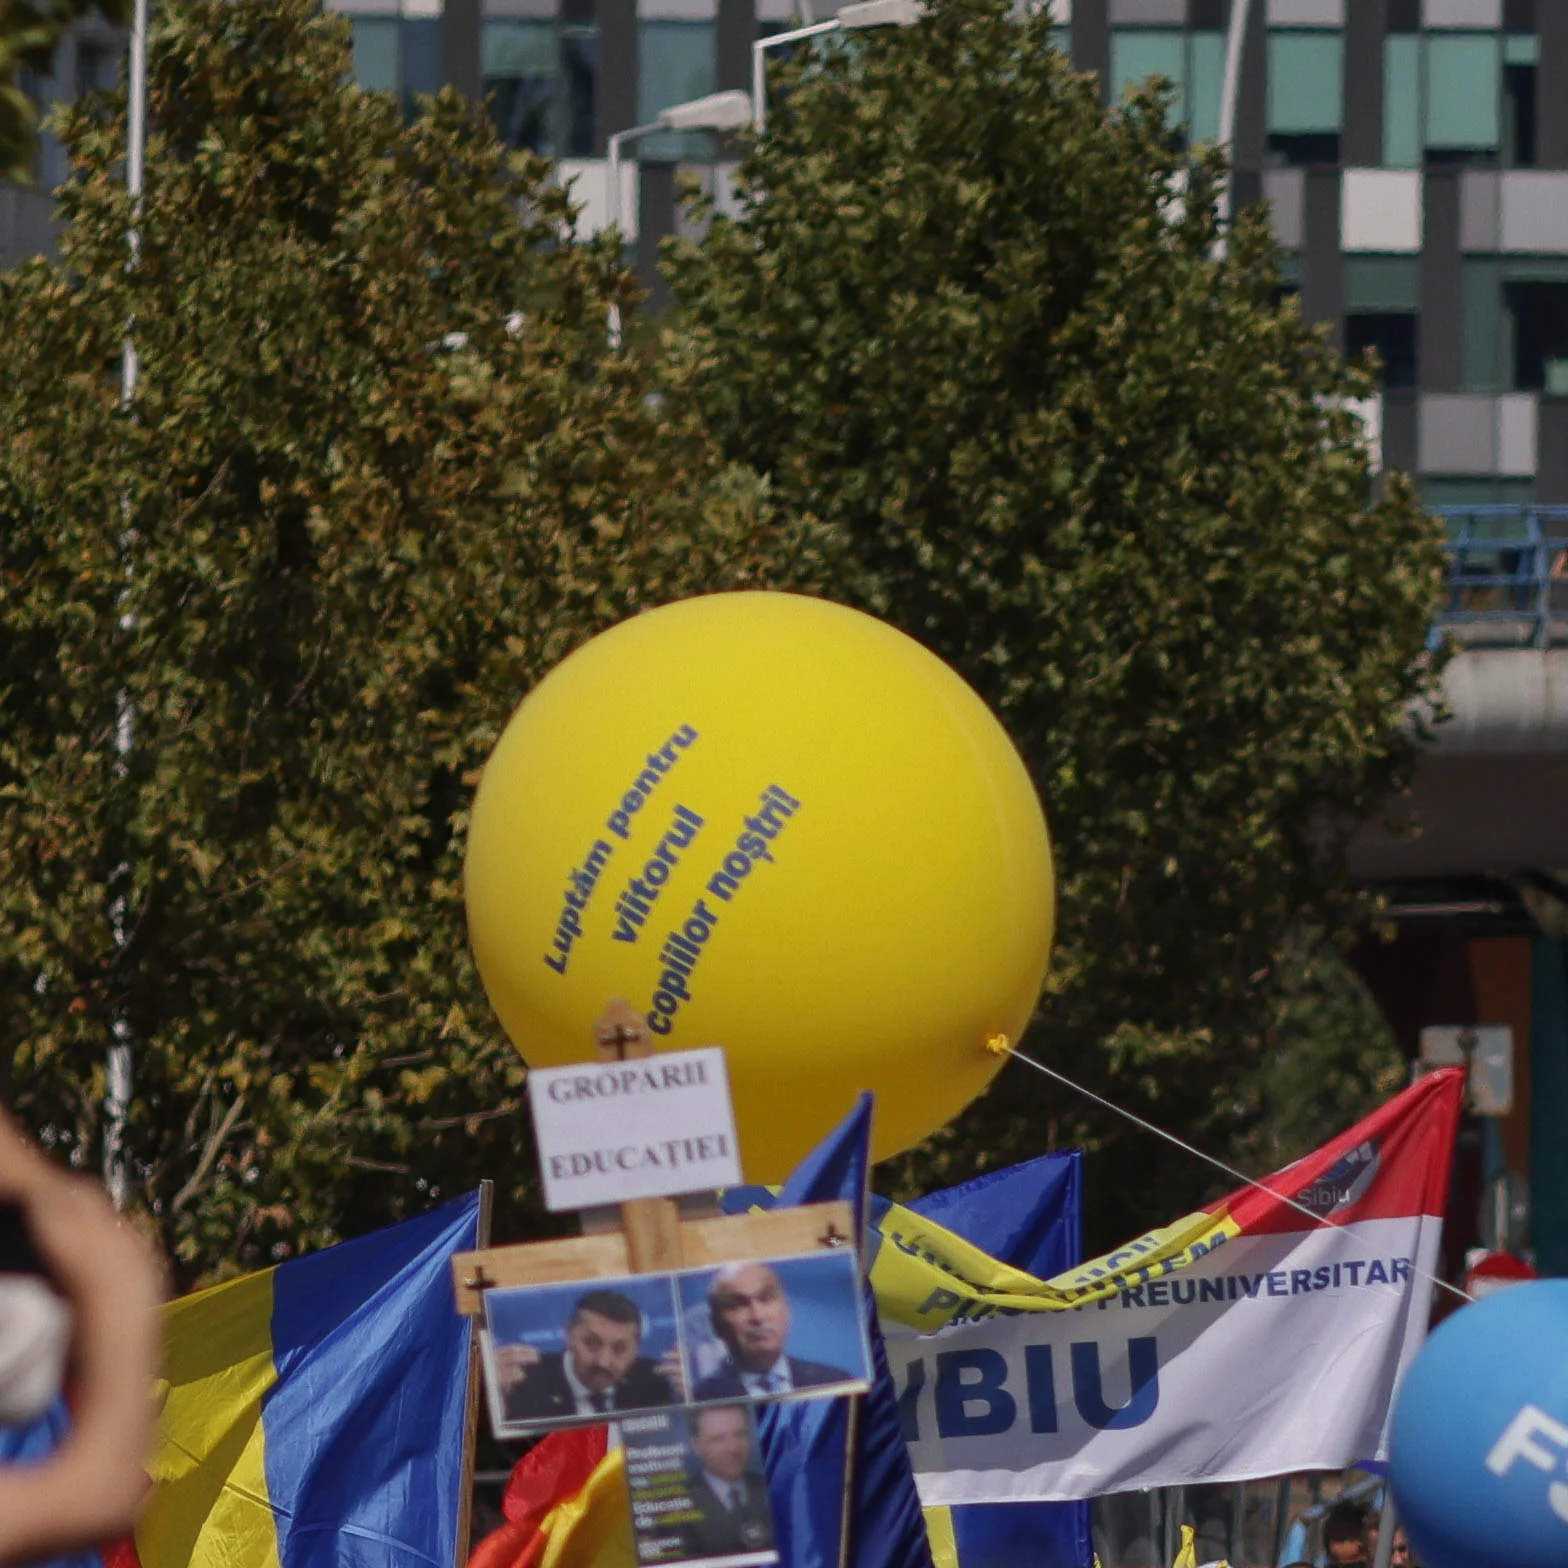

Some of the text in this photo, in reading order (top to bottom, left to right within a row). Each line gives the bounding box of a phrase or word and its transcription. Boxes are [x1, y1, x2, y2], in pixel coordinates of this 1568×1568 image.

[543, 723, 699, 975] Luptăm pentru
[612, 803, 704, 943] viitorul
[646, 898, 719, 1035] copiilor
[548, 1059, 708, 1104] GROPARII
[548, 1133, 729, 1179] EDUCAȚIEI
[1297, 1185, 1350, 1206] Sibiu
